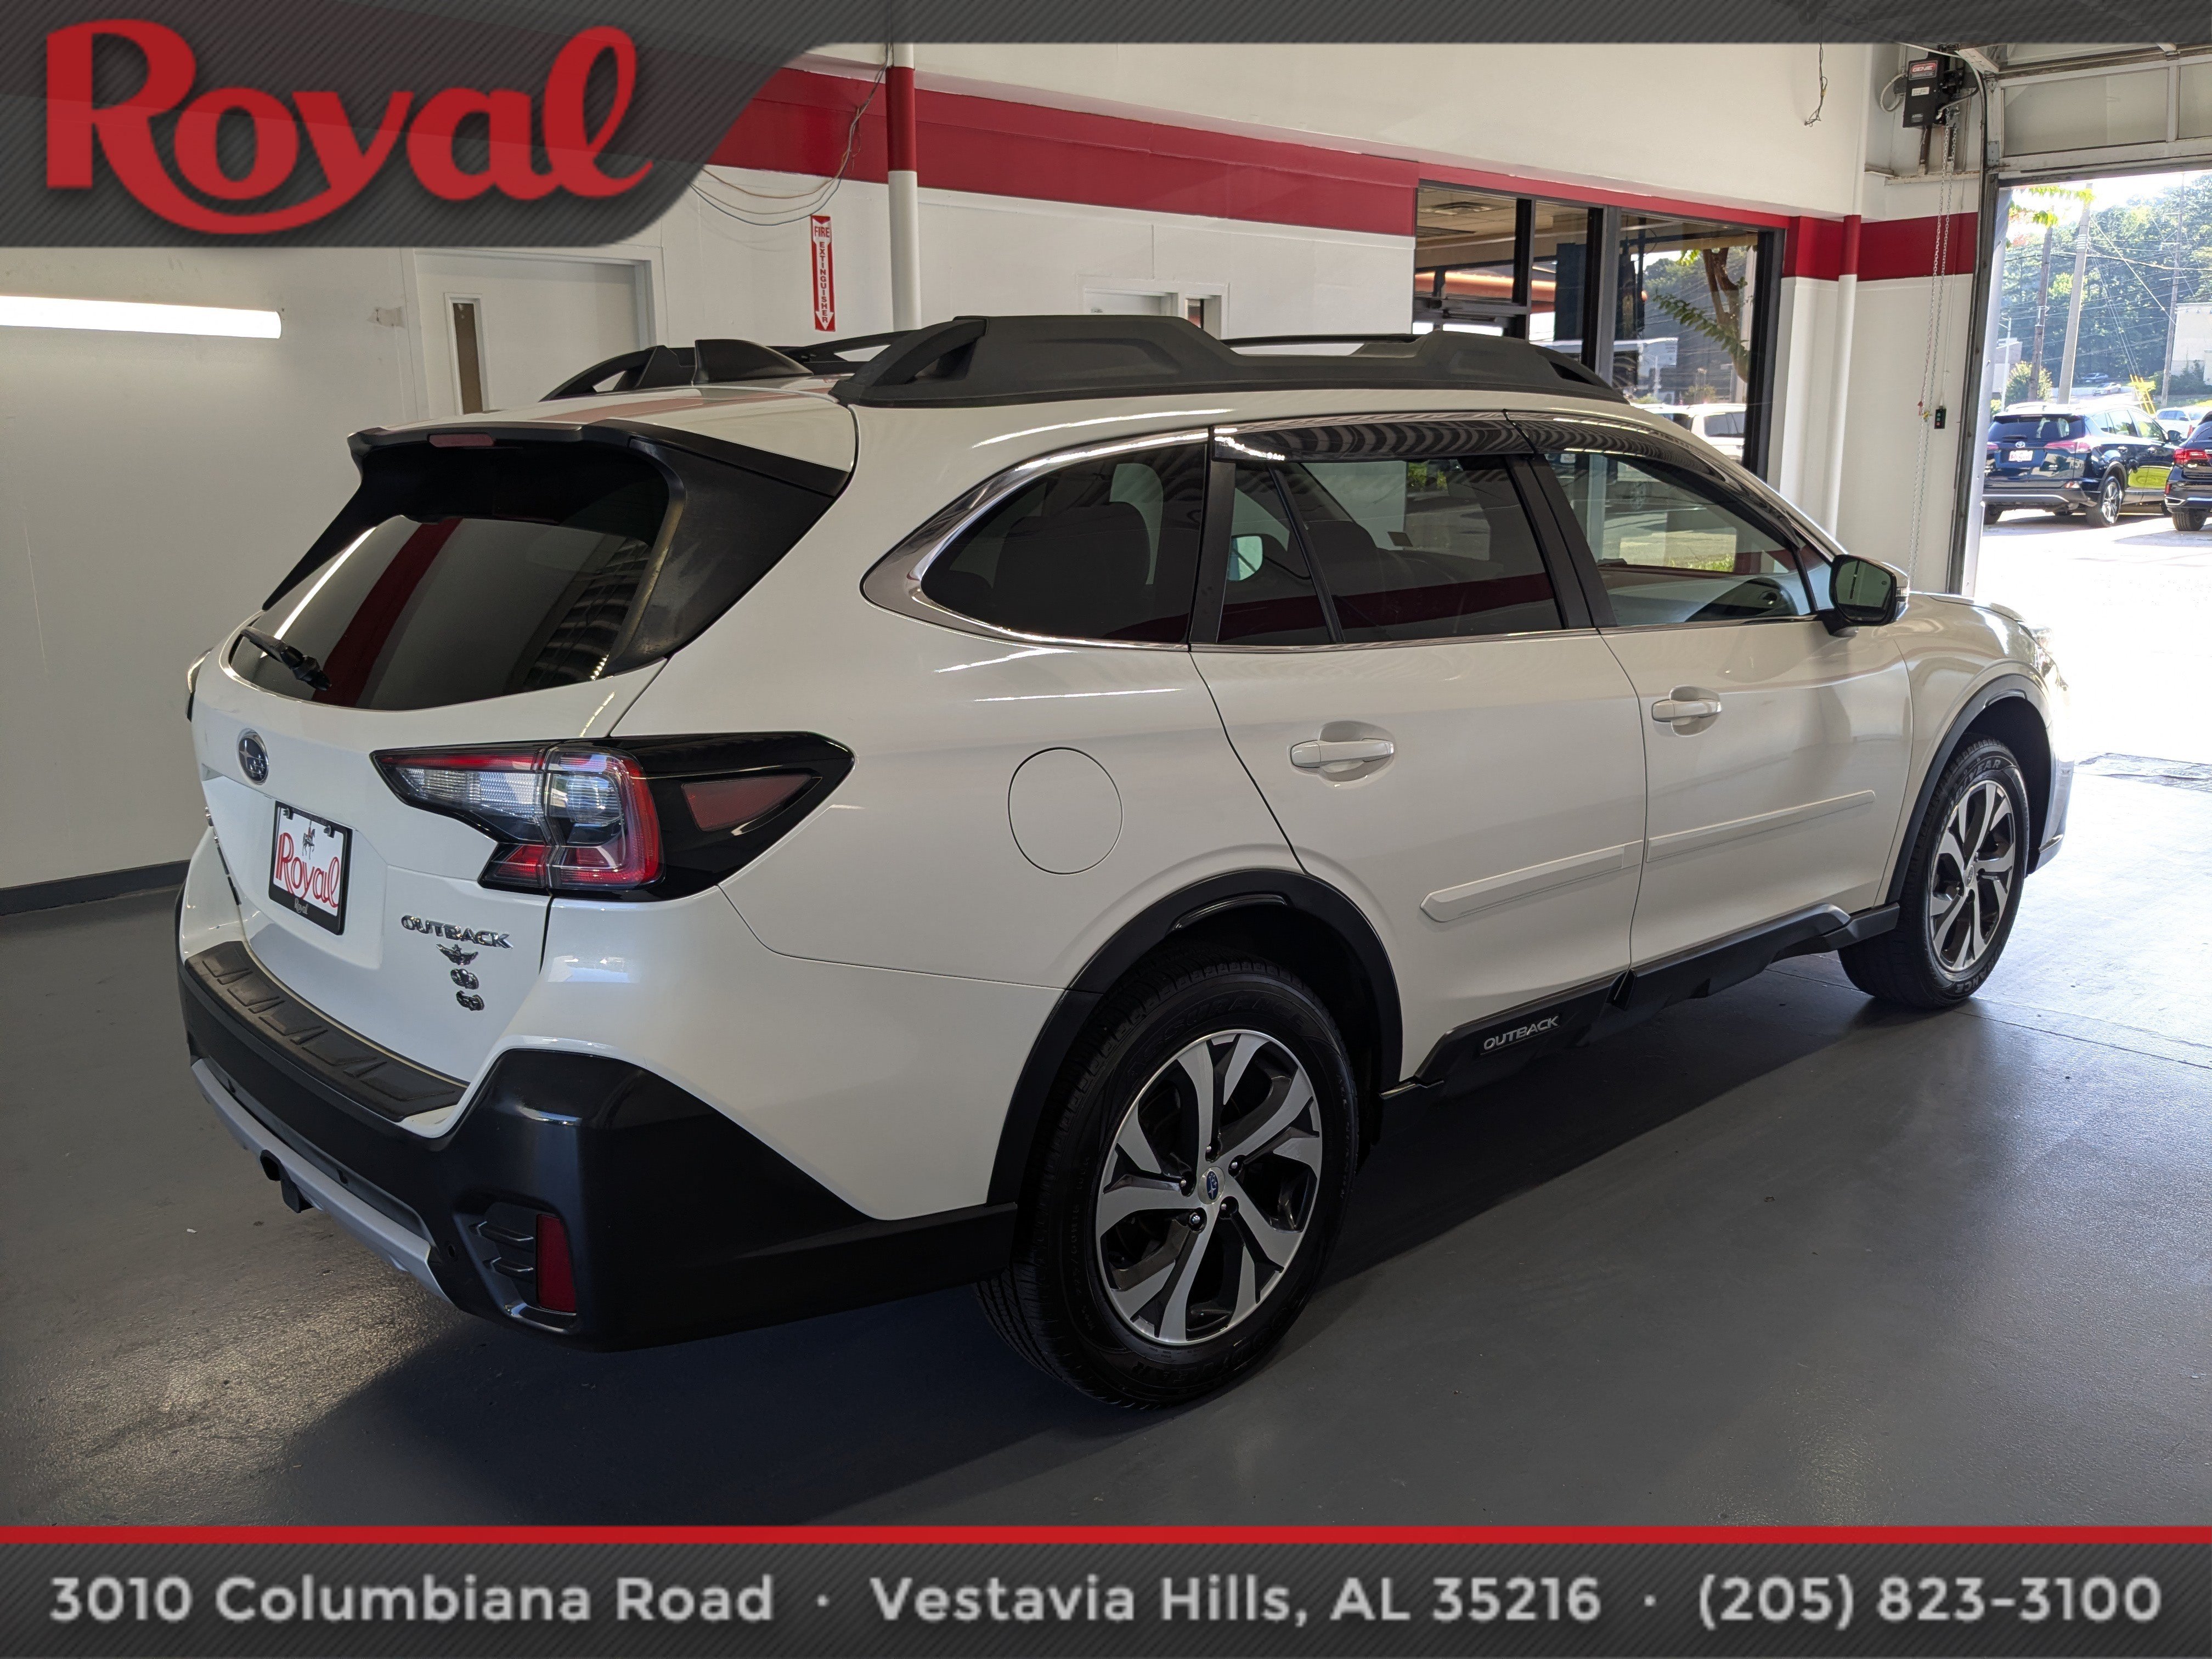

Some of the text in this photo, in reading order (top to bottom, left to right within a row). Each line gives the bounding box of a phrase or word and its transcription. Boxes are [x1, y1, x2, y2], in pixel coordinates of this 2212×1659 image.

[814, 226, 831, 238] FIRE
[819, 241, 828, 323] EXTINGUISHER
[275, 832, 340, 908] Royal
[294, 898, 308, 915] Royal
[401, 915, 514, 949] OUTBACK
[1483, 1015, 1559, 1051] OUTBACK
